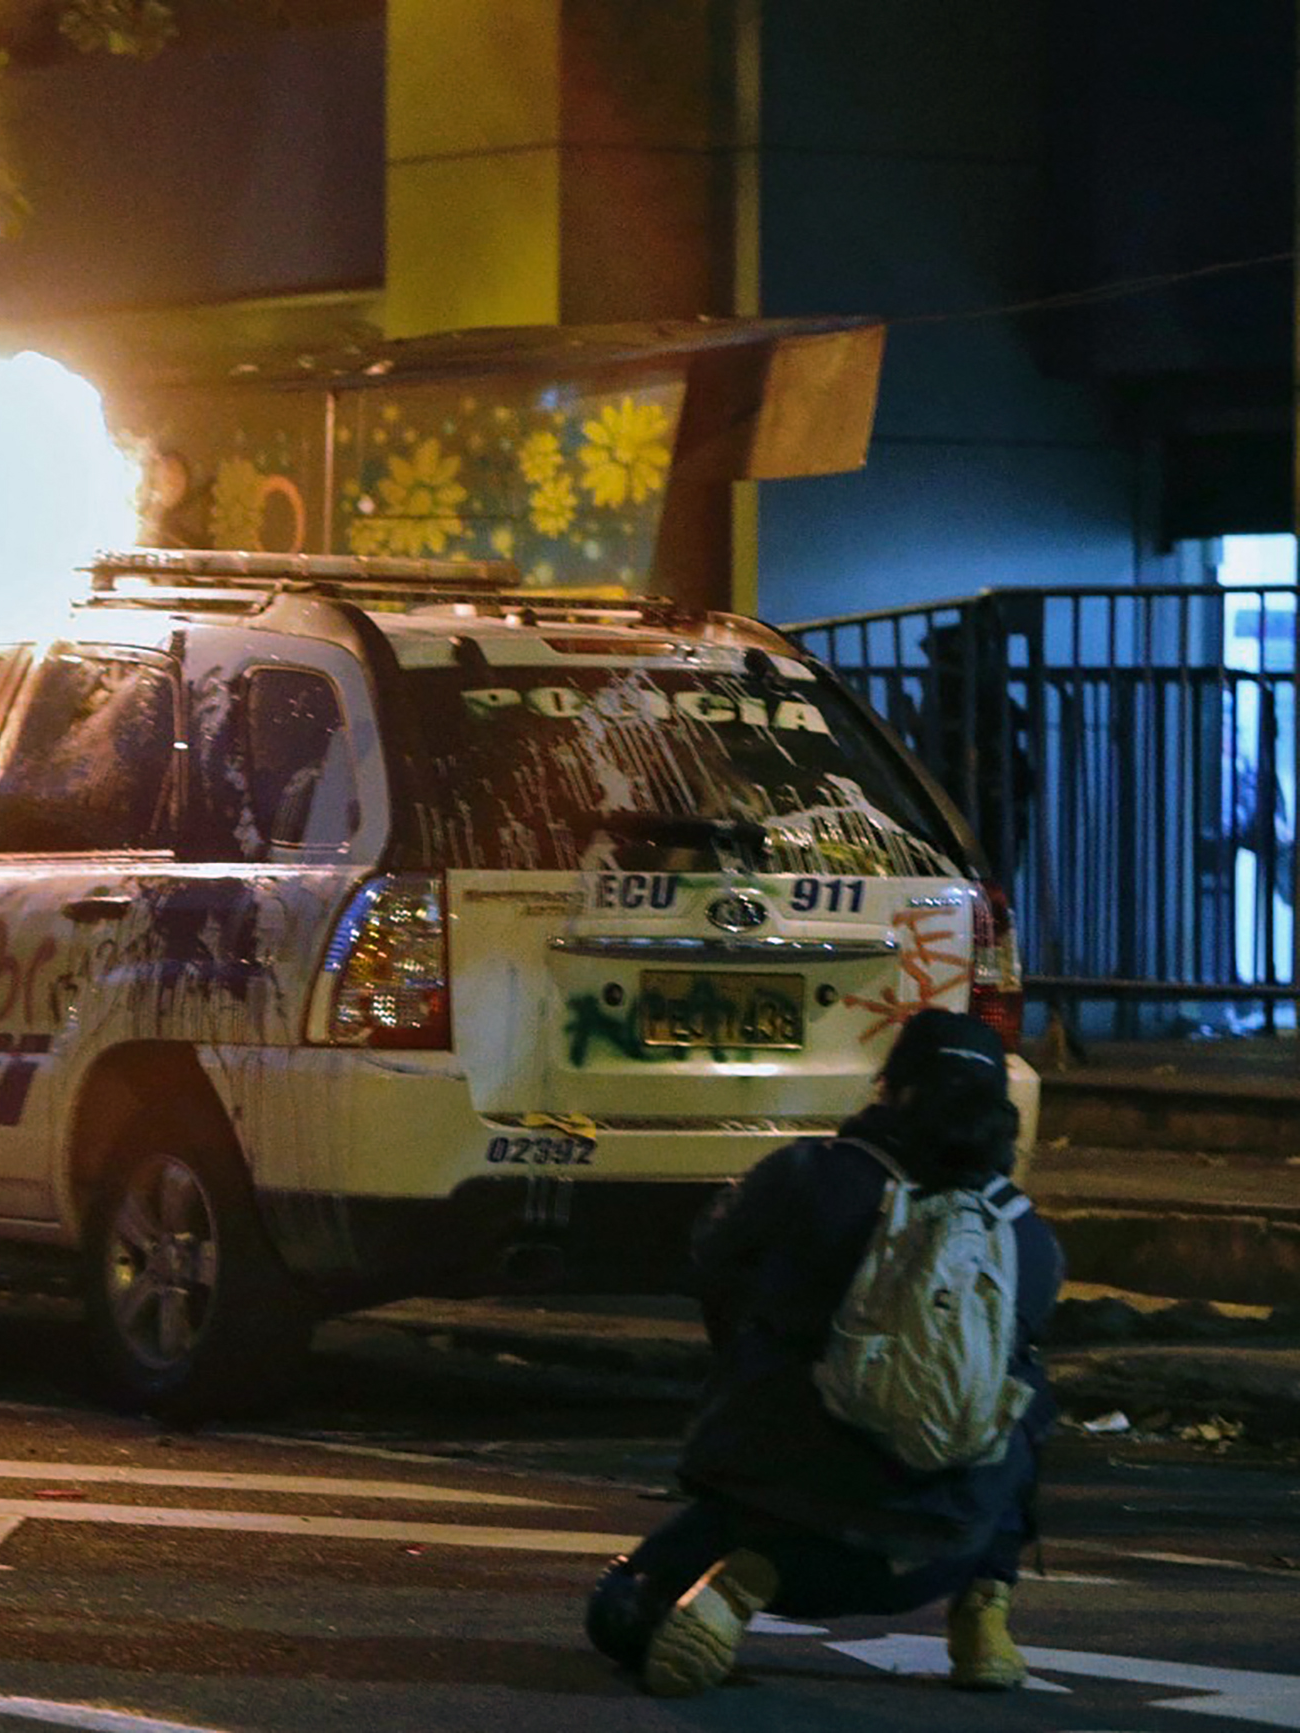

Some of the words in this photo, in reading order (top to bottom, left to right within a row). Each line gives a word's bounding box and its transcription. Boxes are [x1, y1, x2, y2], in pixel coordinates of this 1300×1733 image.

[597, 874, 678, 910] ECU
[791, 878, 865, 913] 911
[487, 1136, 596, 1165] 02392
